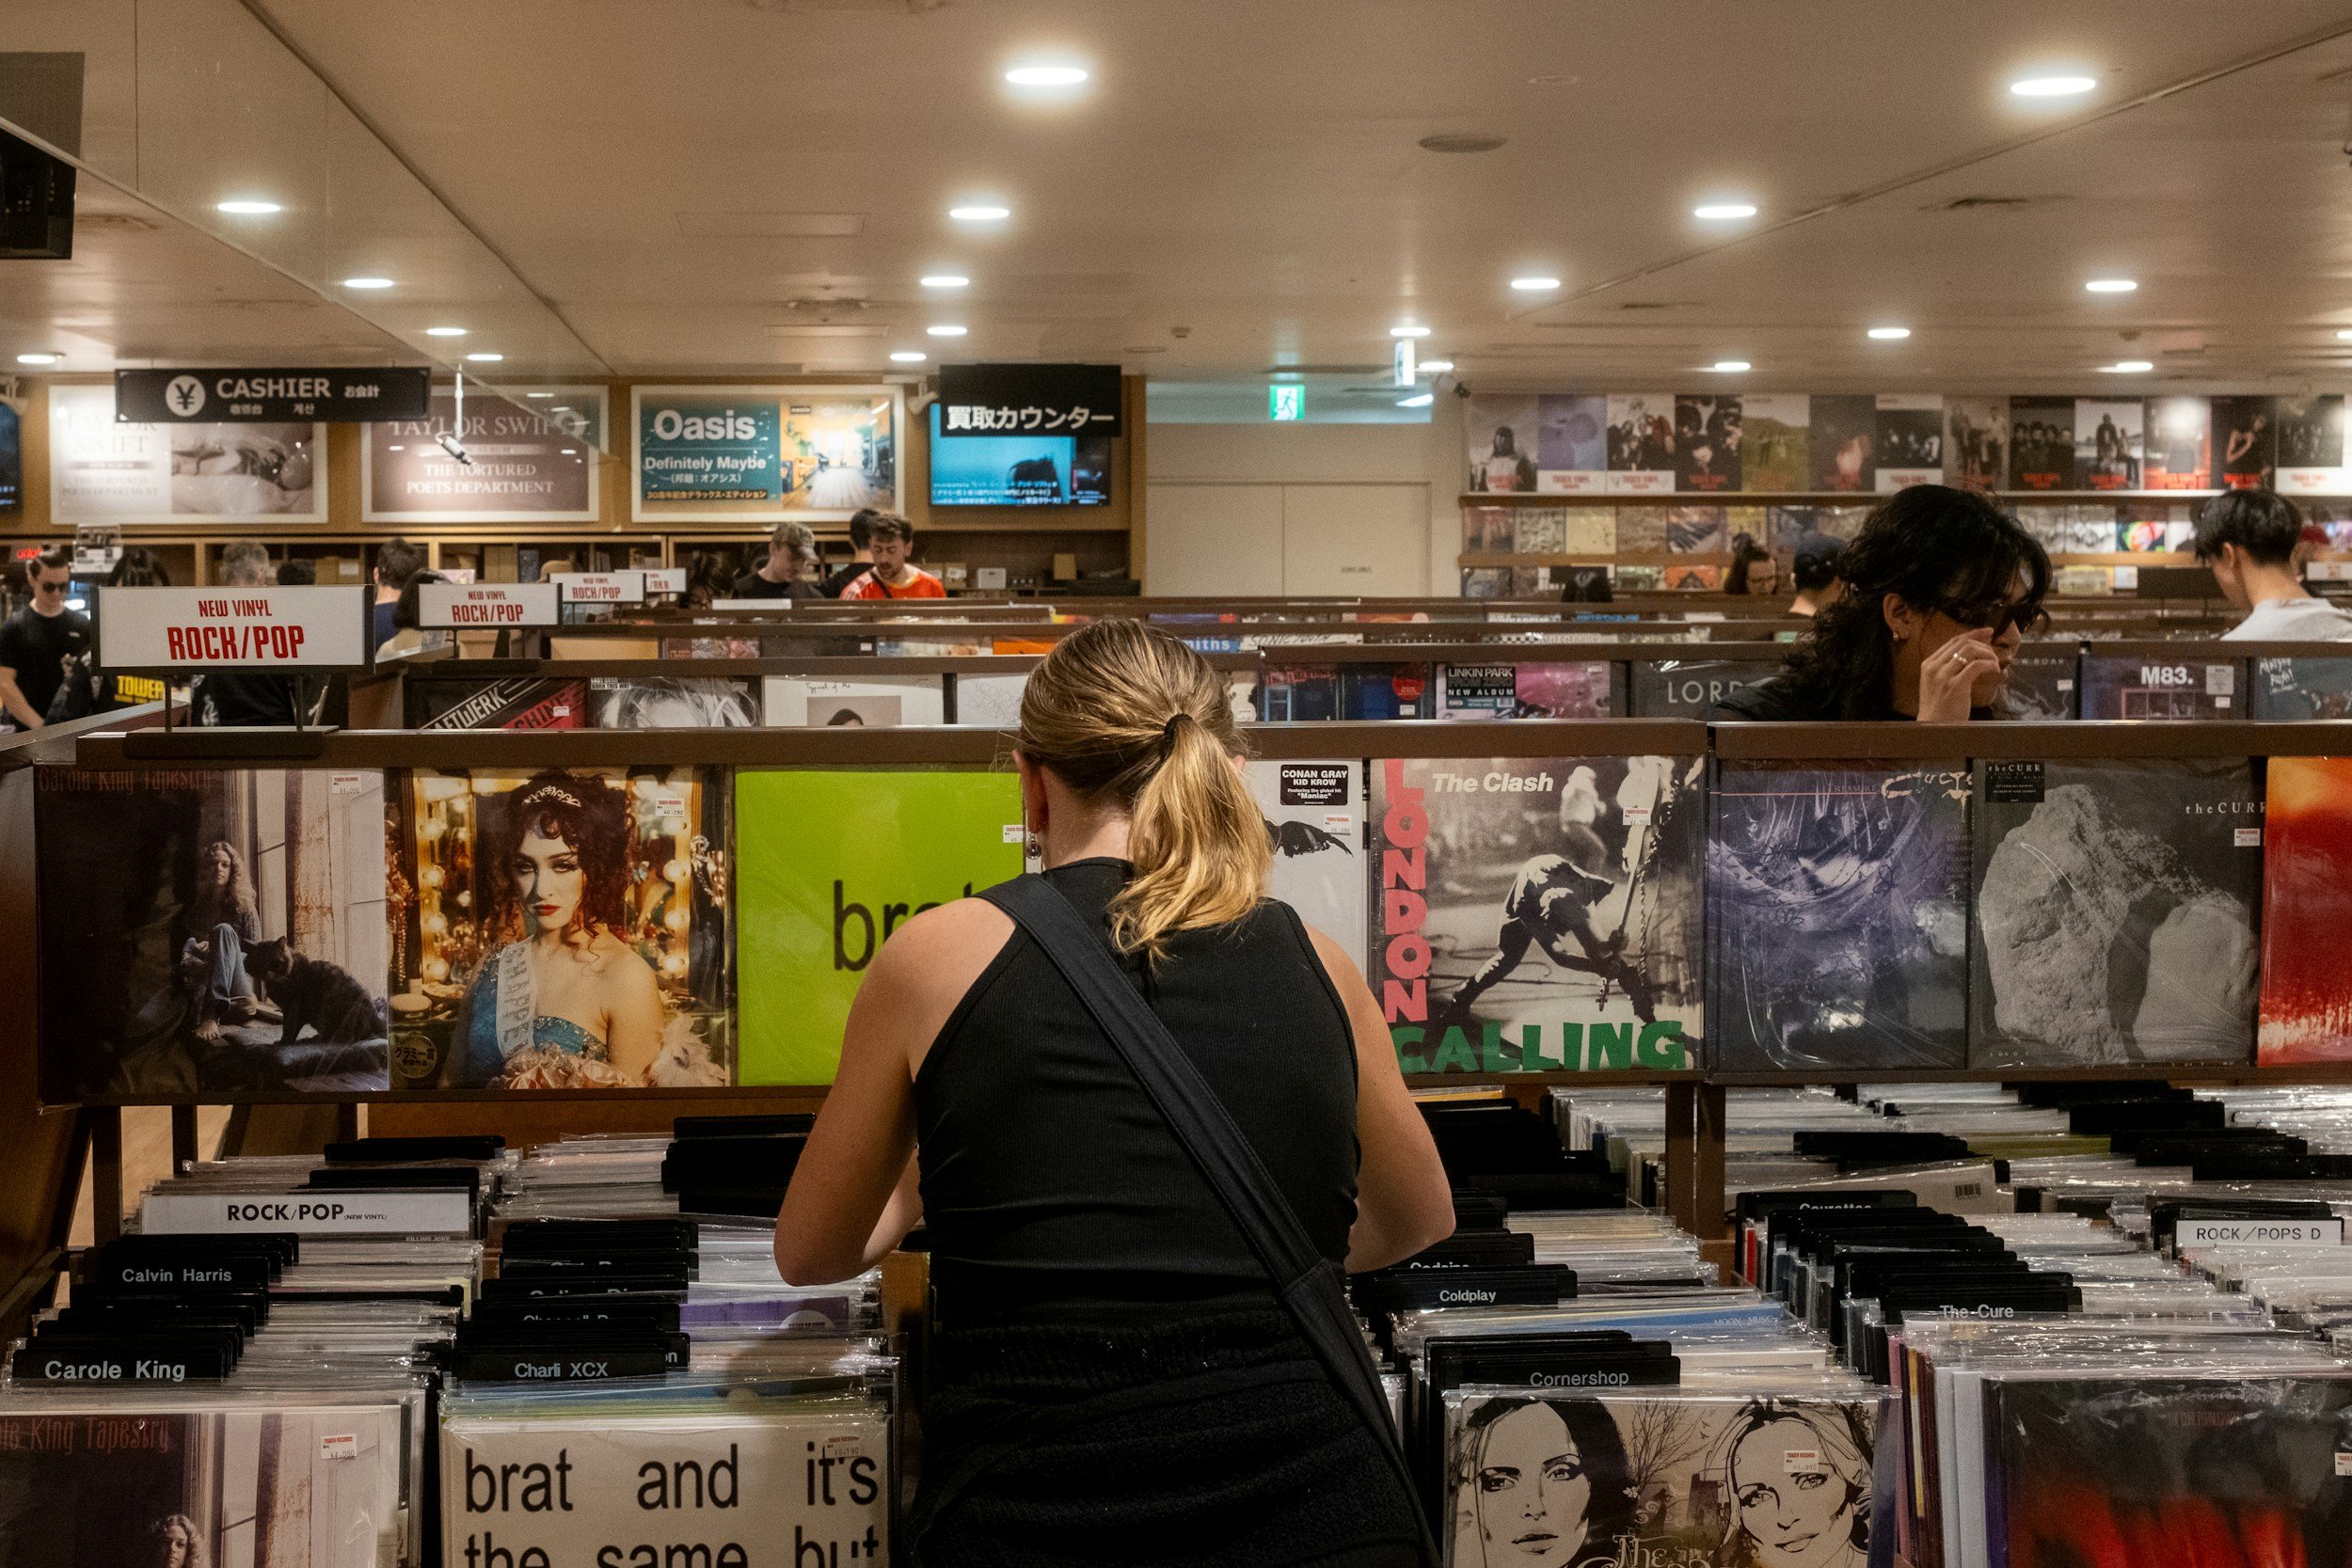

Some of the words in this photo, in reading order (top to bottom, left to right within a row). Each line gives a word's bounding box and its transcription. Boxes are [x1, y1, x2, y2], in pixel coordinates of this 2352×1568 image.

[216, 377, 331, 399] CASHIER
[654, 409, 756, 441] Oasis
[946, 405, 1115, 430] 買取カウンター
[423, 464, 455, 476] THE
[459, 464, 536, 476] TORTURED
[644, 456, 714, 472] Definitely
[717, 456, 767, 472] Maybe
[406, 482, 452, 494] POETS
[454, 482, 554, 494] DEPARTMENT
[468, 591, 485, 601] NEW
[485, 591, 507, 601] VINYL
[572, 587, 621, 599] ROCK/POP
[199, 600, 229, 618] NEW
[234, 599, 273, 617] VINYL
[452, 604, 524, 623] ROCK/POP
[167, 625, 305, 660] ROCK/POP
[1186, 638, 1230, 651] miths
[1449, 668, 1484, 677] LINKIN
[1485, 668, 1513, 677] PARK
[2141, 666, 2193, 685] M83.
[117, 674, 165, 697] TOWER
[1668, 681, 1744, 704] LOR
[434, 685, 508, 729] AFTWERK
[1282, 770, 1317, 779] CONAN
[1321, 770, 1347, 779] GRAY
[1432, 772, 1478, 793] The
[1483, 772, 1554, 793] Clash
[1828, 784, 1878, 792] TREASURE
[1383, 758, 1433, 1023] LONDON
[833, 879, 973, 973] br
[1391, 1020, 1686, 1074] CALLING
[227, 1203, 345, 1222] ROCK/POP
[2311, 1227, 2321, 1241] D
[121, 1268, 173, 1283] Calvin
[183, 1267, 232, 1282] Harris
[1439, 1290, 1497, 1304] Coldplay
[1939, 1304, 1969, 1319] The
[1978, 1304, 2014, 1319] Cure
[1713, 1317, 1741, 1328] MOON
[44, 1360, 122, 1380] Carole
[135, 1359, 185, 1383] King
[515, 1362, 562, 1378] Charli
[570, 1362, 609, 1378] XCX
[1530, 1370, 1630, 1386] Cornershop
[465, 1448, 574, 1513] brat
[637, 1443, 739, 1510] and
[806, 1441, 880, 1506] it's
